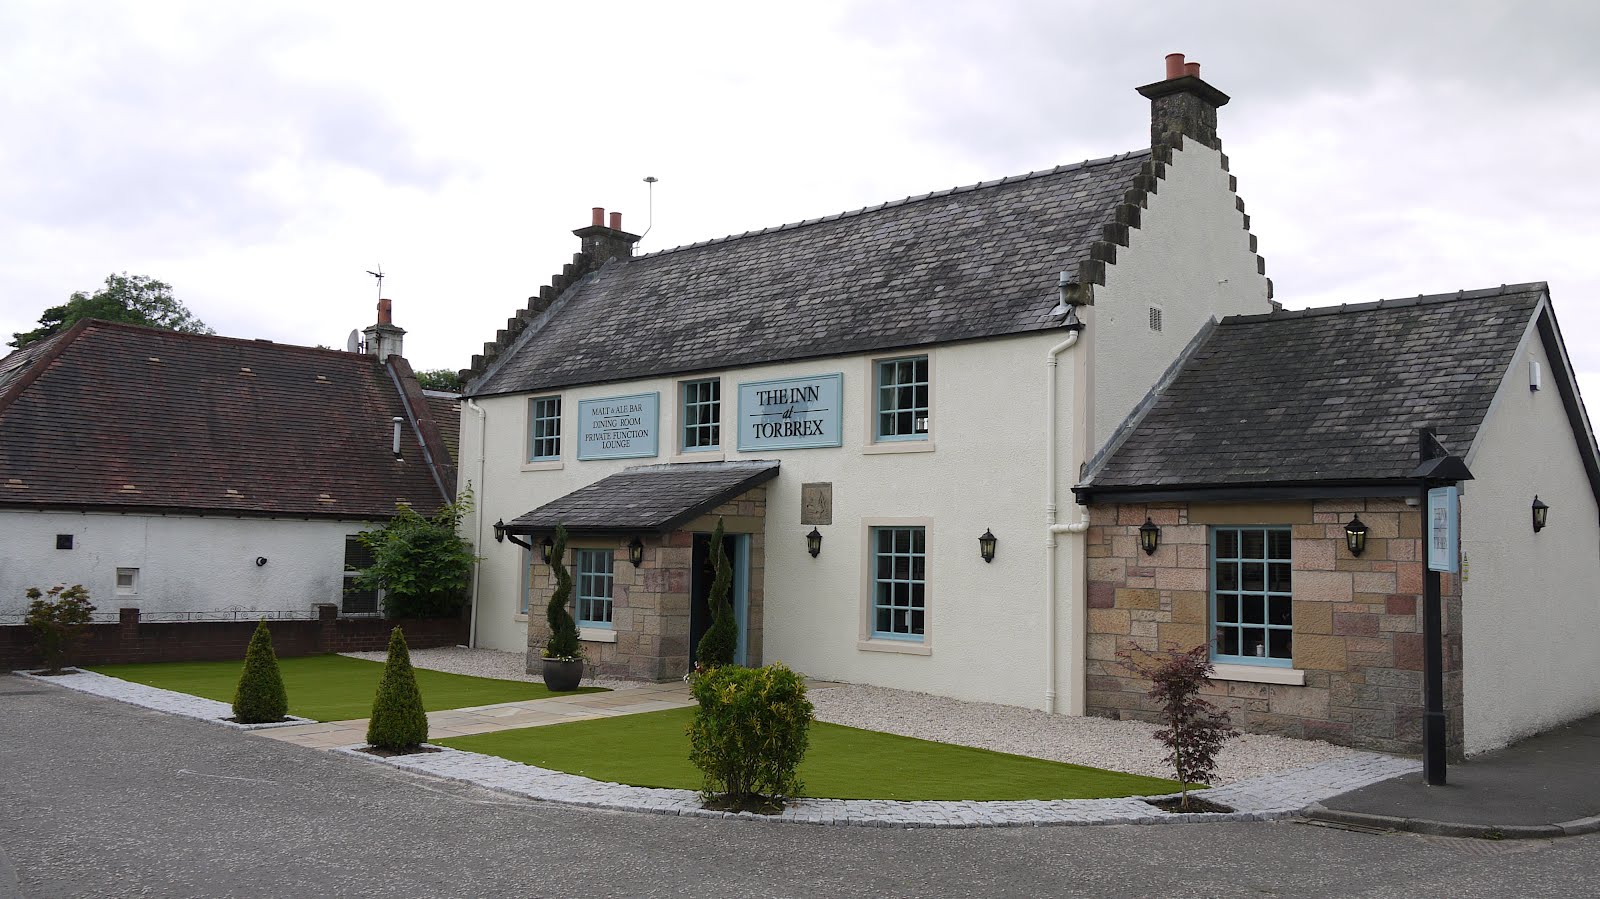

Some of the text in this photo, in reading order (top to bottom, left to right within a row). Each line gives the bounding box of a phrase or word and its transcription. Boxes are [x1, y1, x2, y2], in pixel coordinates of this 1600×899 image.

[757, 385, 819, 406] THE INN
[592, 407, 610, 416] MALT
[616, 405, 628, 414] ALE
[629, 404, 642, 412] BAR
[782, 406, 793, 418] at
[593, 417, 640, 428] DINING ROOM
[753, 419, 824, 439] TORBREX
[585, 430, 648, 441] PRIVATE FUNCTION
[602, 440, 630, 449] LOUNGE
